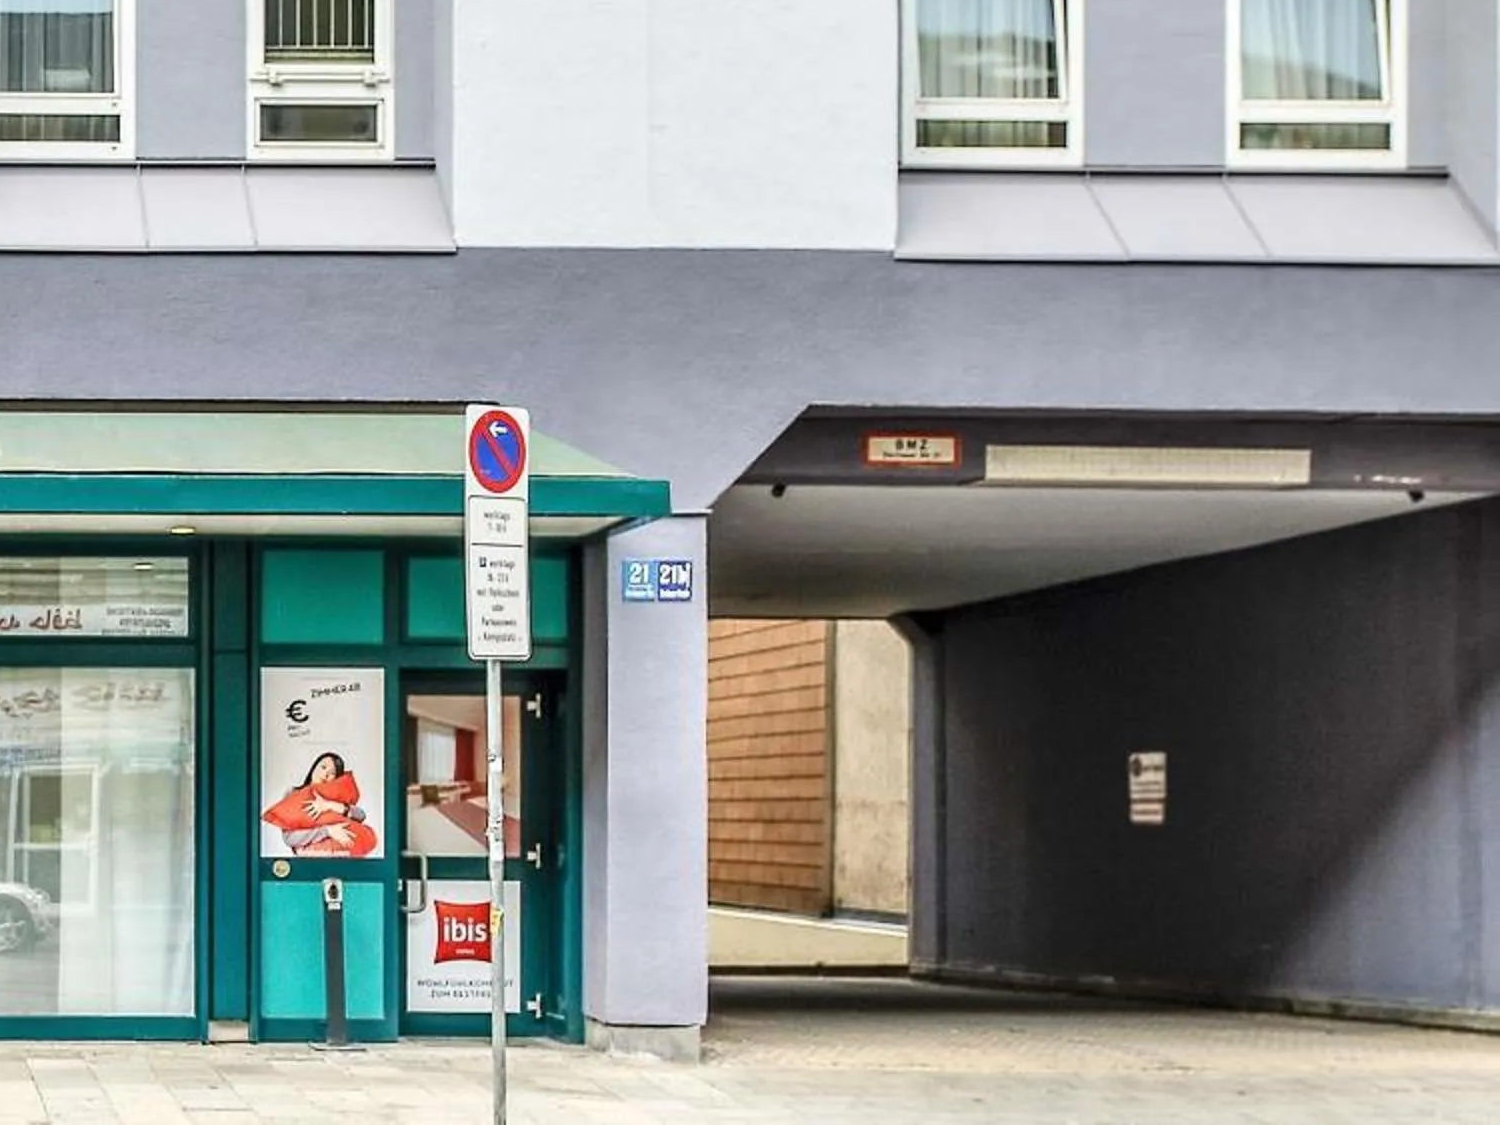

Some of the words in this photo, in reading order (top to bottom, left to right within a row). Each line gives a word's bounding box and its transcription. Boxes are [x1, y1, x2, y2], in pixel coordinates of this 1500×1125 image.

[629, 562, 650, 584] 21
[285, 699, 310, 724] €
[443, 916, 488, 942] ibis
